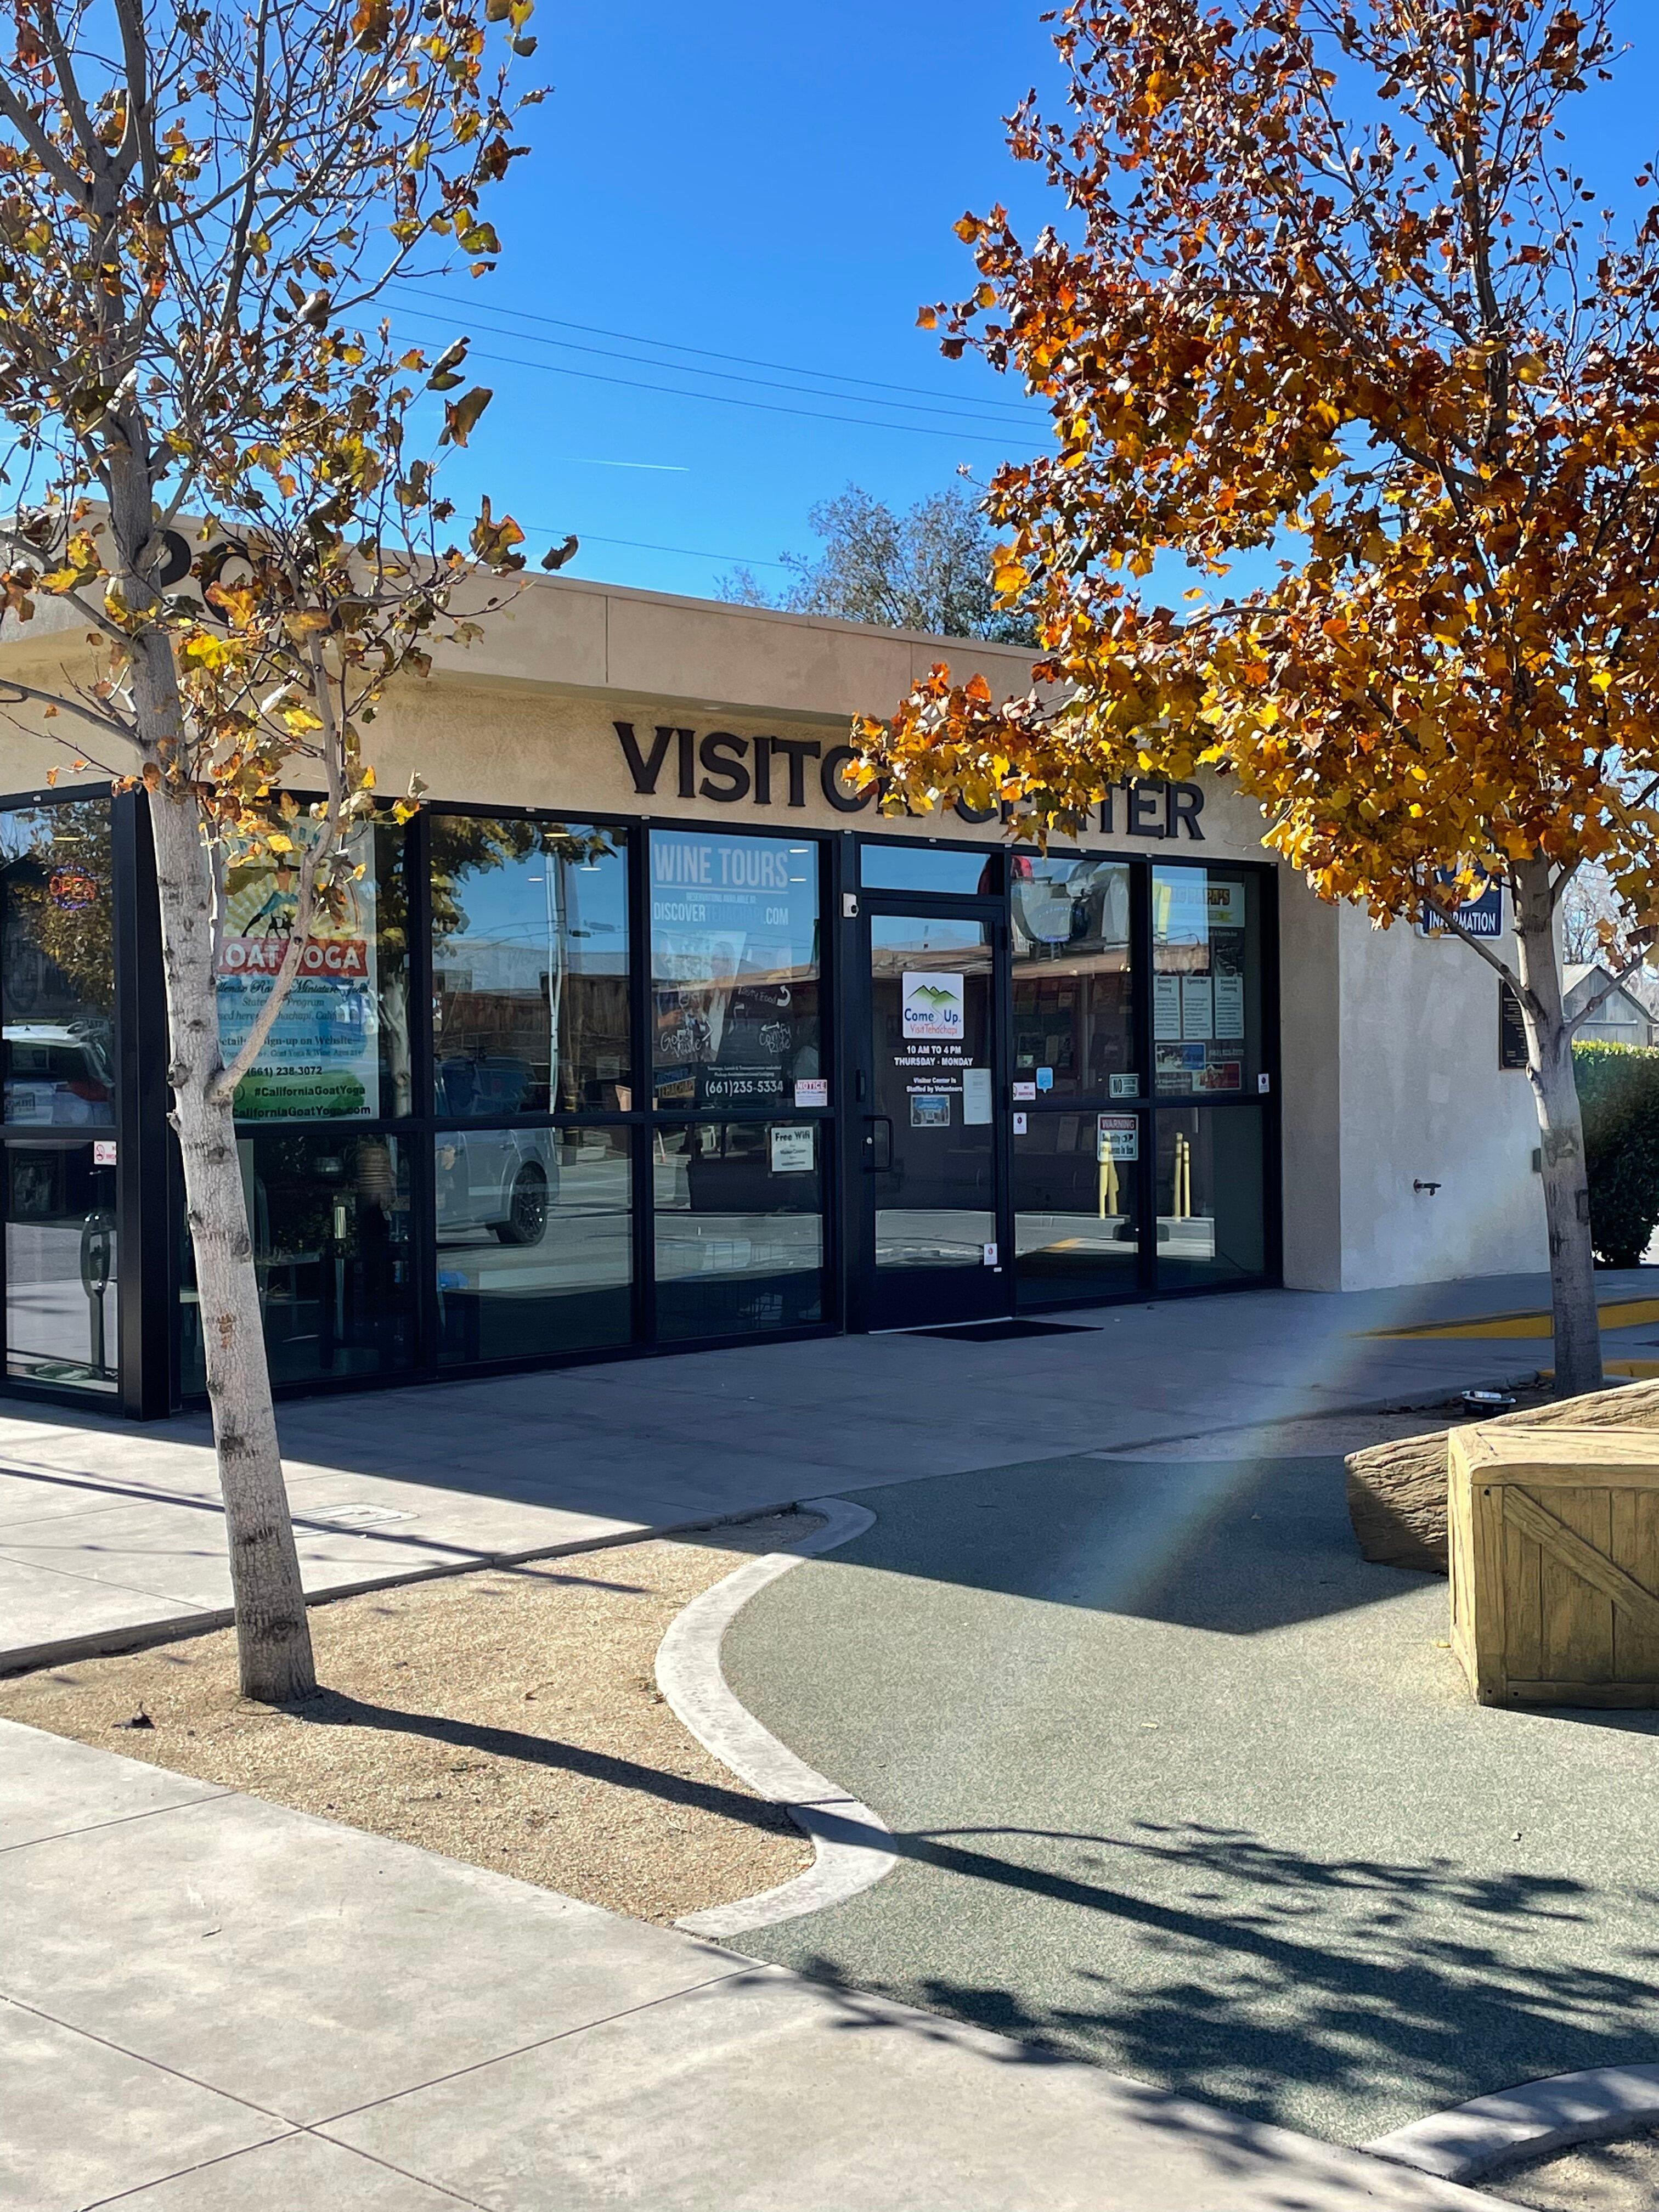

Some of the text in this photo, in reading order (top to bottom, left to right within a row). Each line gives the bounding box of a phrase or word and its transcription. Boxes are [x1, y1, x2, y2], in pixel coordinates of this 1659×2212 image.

[654, 844, 788, 888] WINE TOURS
[219, 943, 361, 969] OAT OGA
[905, 1008, 934, 1022] Come
[910, 1023, 957, 1035] Visit Tehachapi
[907, 1045, 962, 1054] 10 AM TO 4 PM
[894, 1057, 936, 1066] THURSDAY
[941, 1057, 974, 1066] MONDAY
[247, 1066, 323, 1078] (661) 238-3072
[255, 1086, 365, 1097] #CaliforniaGoatYoga
[706, 1080, 783, 1097] (661)235-5334
[1113, 1079, 1122, 1093] NO
[1102, 1118, 1135, 1129] WARNING
[775, 1132, 792, 1141] Free
